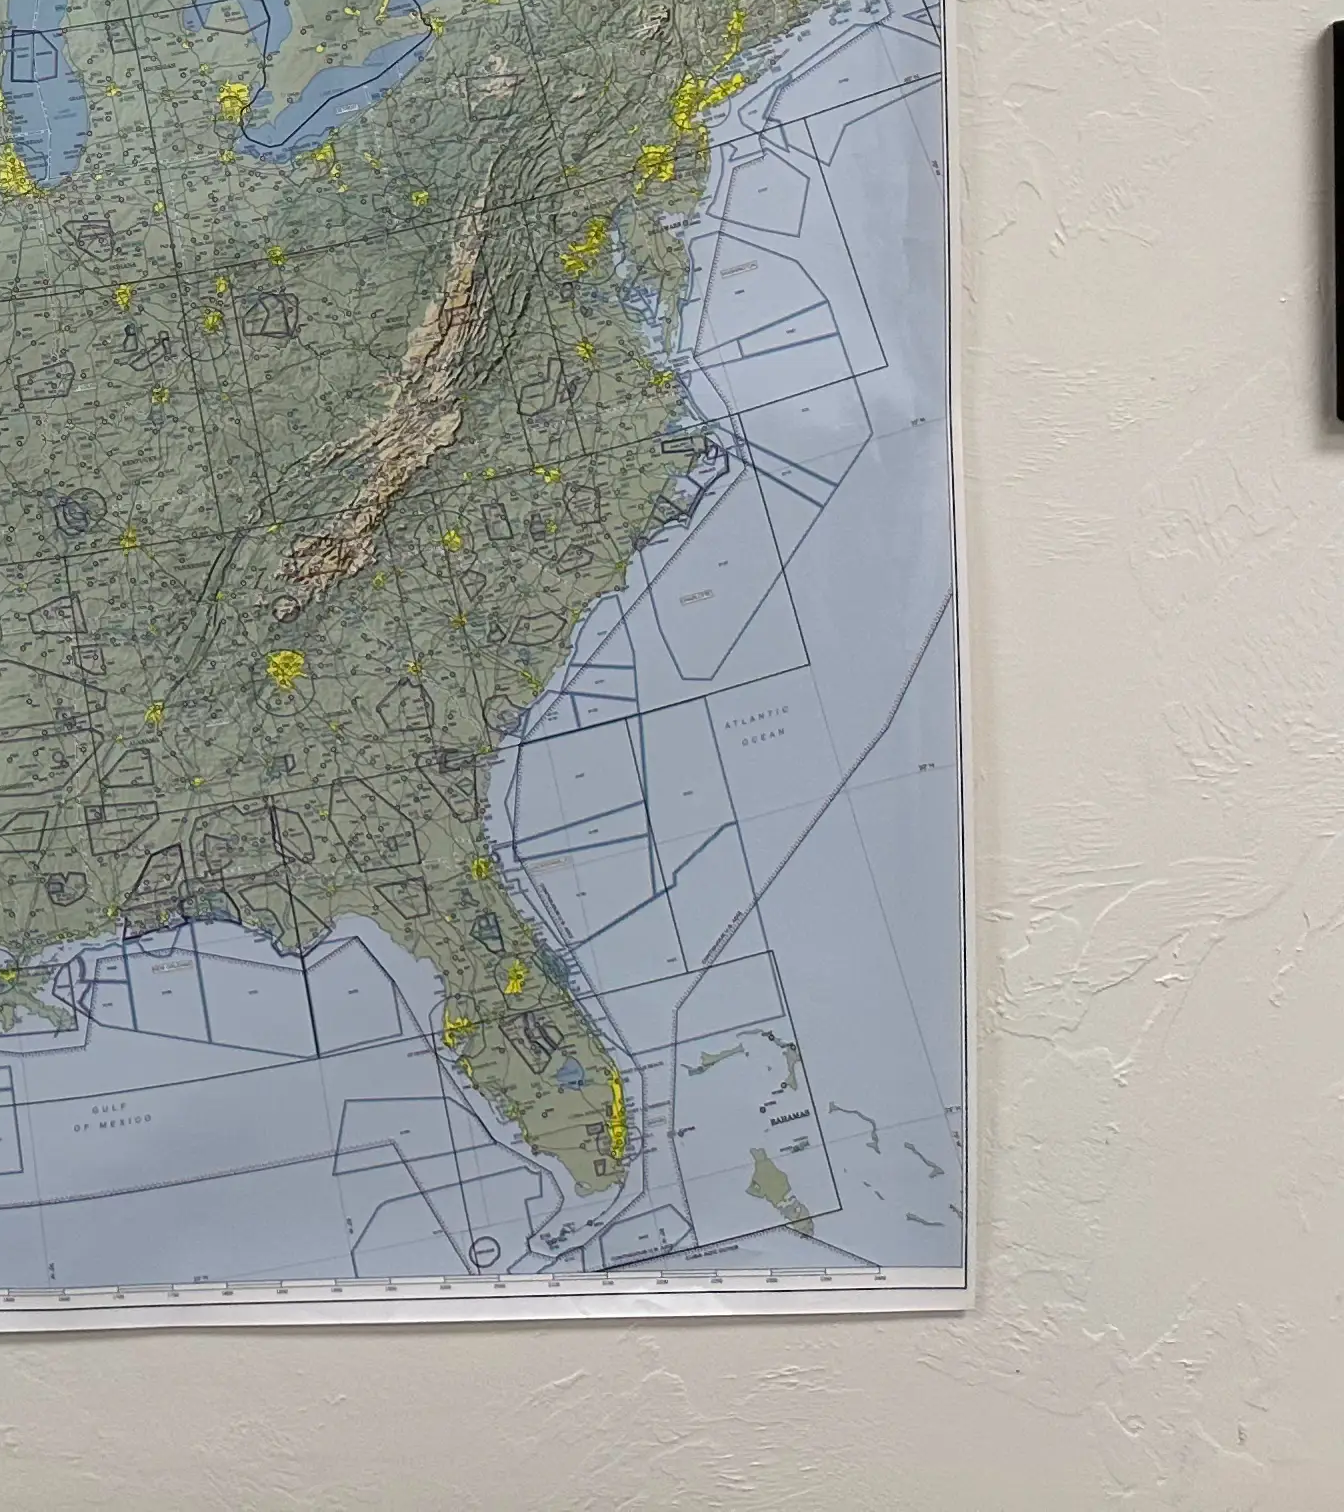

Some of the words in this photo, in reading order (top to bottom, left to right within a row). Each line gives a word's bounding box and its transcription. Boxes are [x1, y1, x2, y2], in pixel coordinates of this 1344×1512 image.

[725, 706, 788, 729] ATLANTIC
[742, 728, 784, 746] OCEAN
[92, 1102, 126, 1114] GULF
[74, 1124, 89, 1132] OF
[99, 1114, 151, 1128] MEXICO
